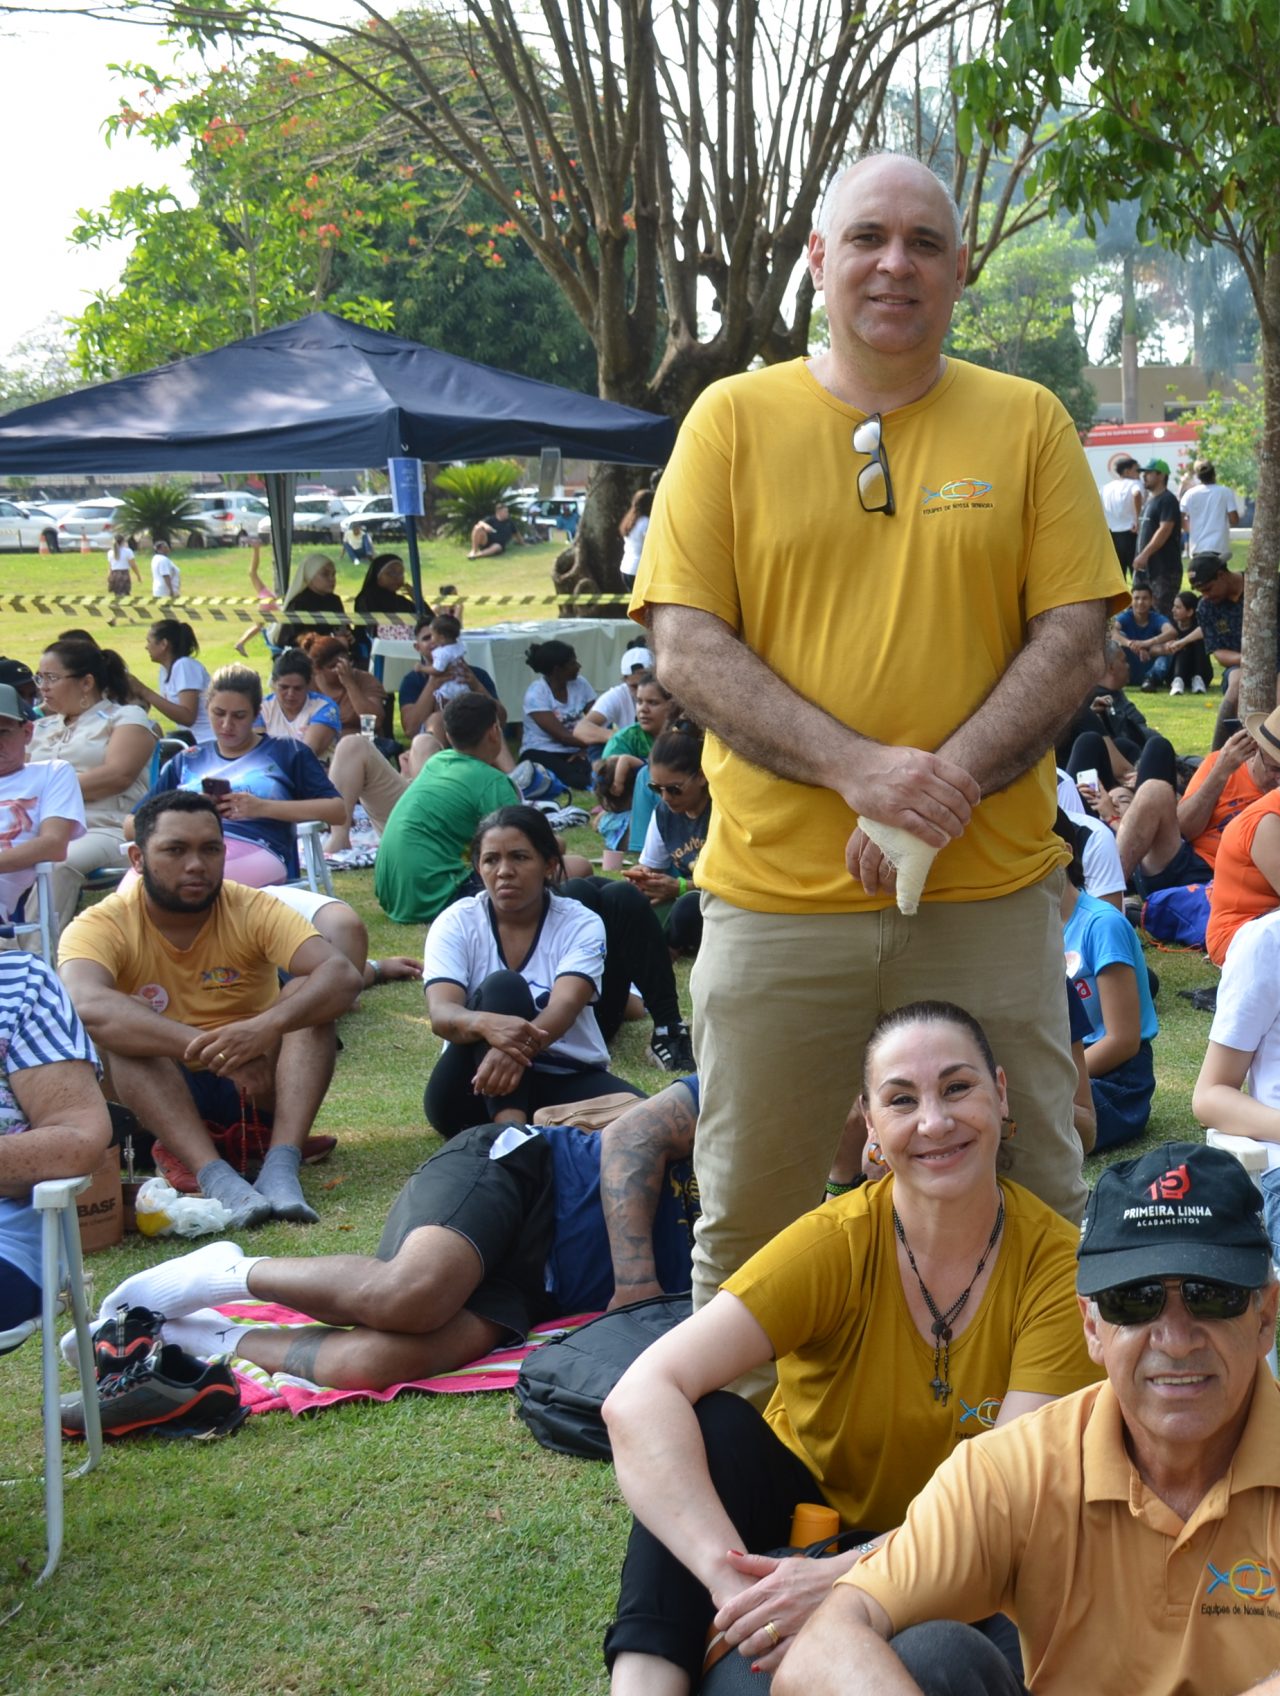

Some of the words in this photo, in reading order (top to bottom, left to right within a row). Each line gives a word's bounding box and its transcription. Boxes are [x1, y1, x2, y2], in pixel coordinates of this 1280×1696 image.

[76, 1197, 116, 1219] BASF
[1123, 1205, 1175, 1220] PRIMEIRA
[1177, 1205, 1213, 1217] LINHA
[1136, 1217, 1200, 1228] ACABAMENTOS
[1201, 1603, 1230, 1617] Equipes
[1232, 1603, 1241, 1614] de
[1243, 1603, 1265, 1616] Nossa
